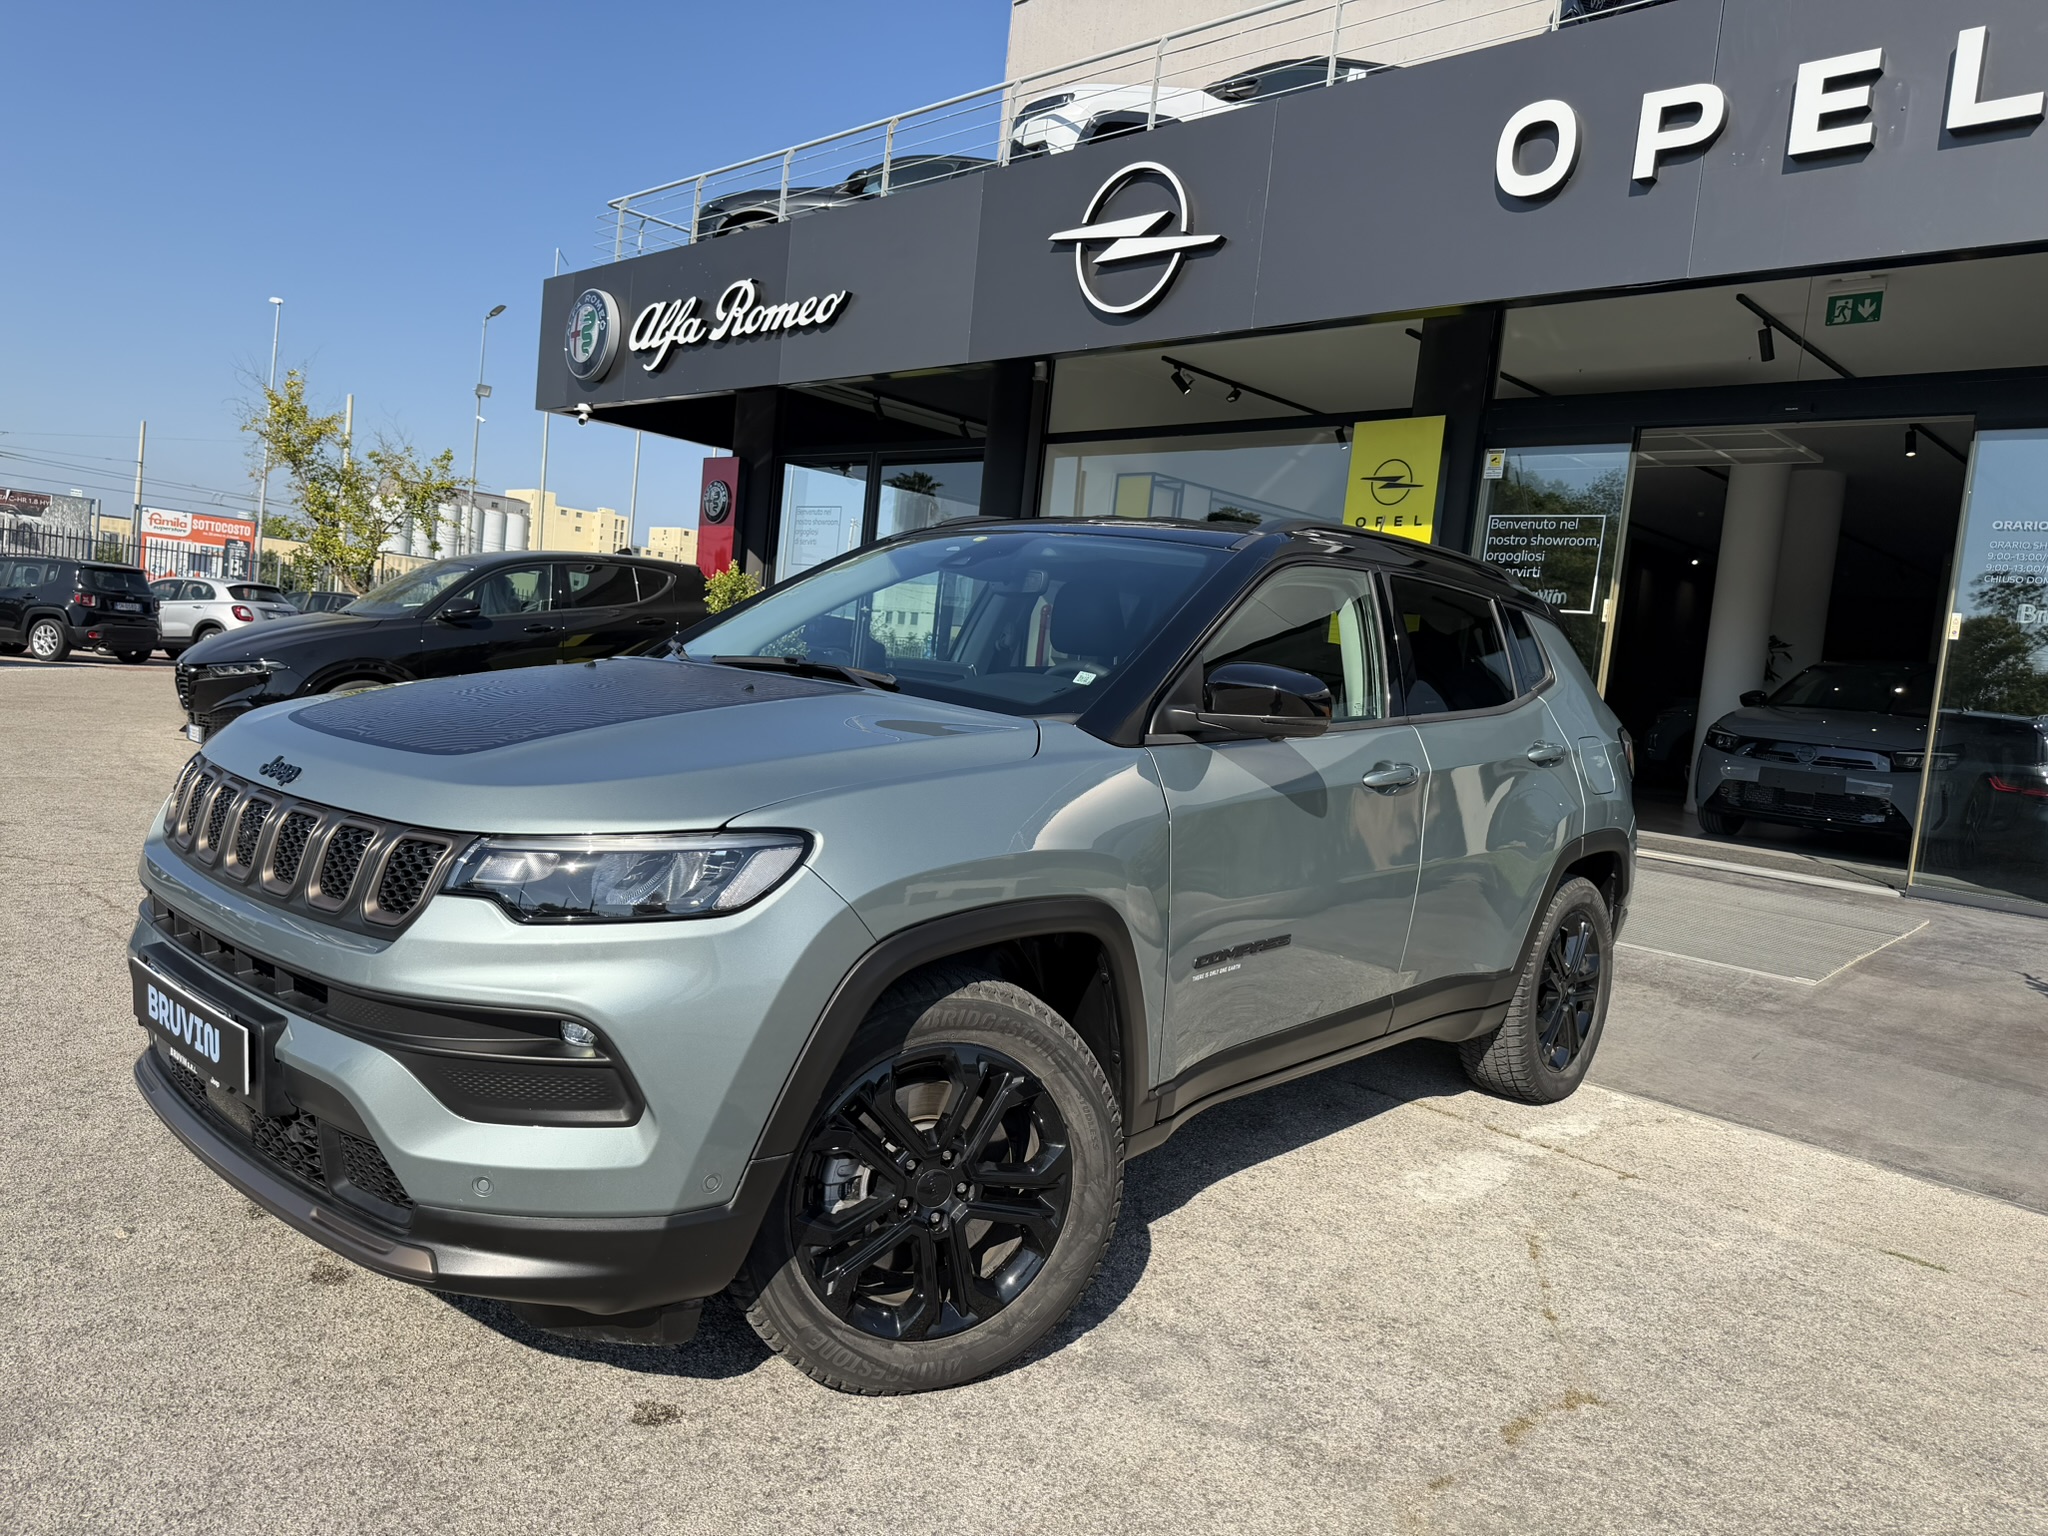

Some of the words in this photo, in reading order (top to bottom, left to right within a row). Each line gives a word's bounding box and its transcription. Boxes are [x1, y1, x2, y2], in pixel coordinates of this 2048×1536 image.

[1495, 26, 2045, 197] OPEL
[585, 294, 606, 331] ROMEO
[629, 295, 707, 371] Alfa
[708, 278, 846, 341] Romeo
[148, 512, 188, 529] famila
[192, 519, 251, 537] SOTTOCOSTO
[1355, 515, 1423, 528] OPEL
[1490, 518, 1557, 530] Benvenuto
[1559, 518, 1580, 530] nel
[1992, 520, 2048, 530] ORARIO
[1488, 534, 1527, 546] nostro
[1530, 534, 1600, 548] showroom,
[1989, 541, 2031, 550] ORARIO
[1486, 550, 1546, 563] orgogliosi
[1984, 574, 2024, 584] CHIUSO
[259, 755, 302, 787] Jeep
[147, 983, 220, 1064] BRUVIN
[921, 1006, 1066, 1064] BRIDGESTONE
[806, 1329, 962, 1382] BRIDGESTONE
